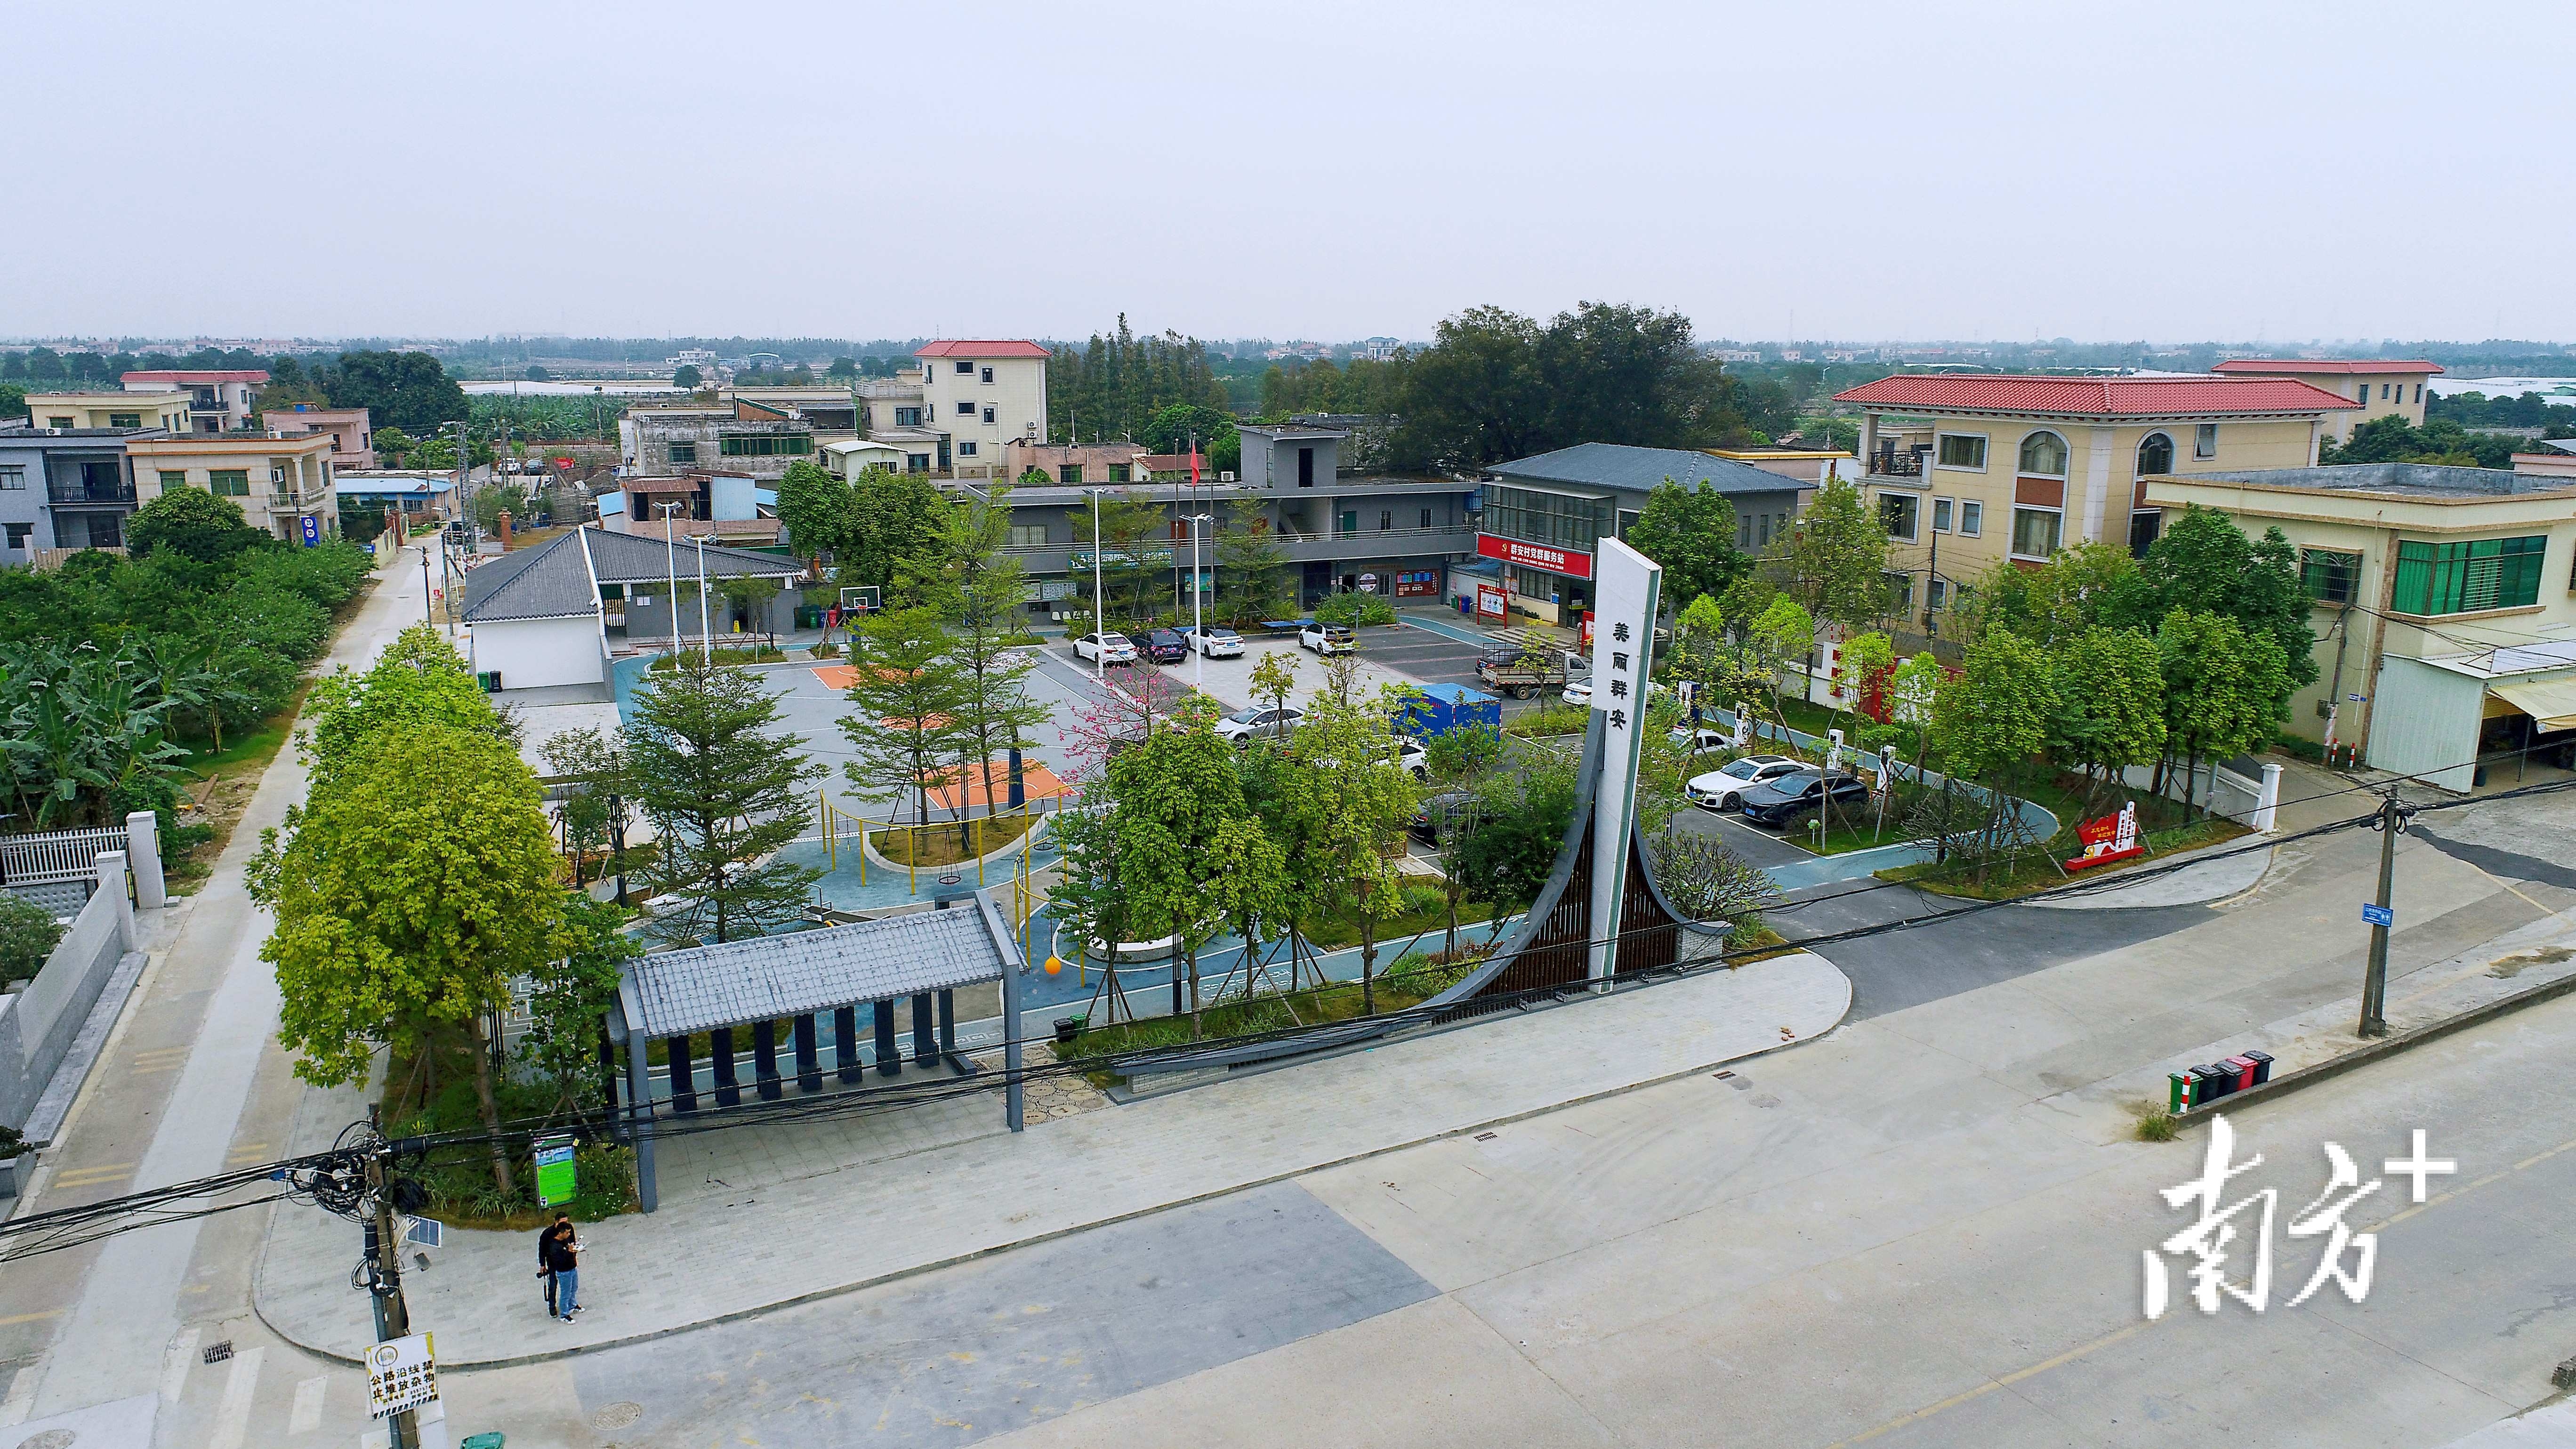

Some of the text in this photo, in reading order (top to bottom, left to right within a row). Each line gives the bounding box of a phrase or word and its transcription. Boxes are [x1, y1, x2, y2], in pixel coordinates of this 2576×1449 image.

[1511, 544, 1564, 564] 群安村党群服务站
[1610, 622, 1629, 730] 美丽群安
[370, 1360, 434, 1386] 公路沿线禁
[373, 1372, 435, 1399] 止堆放杂物
